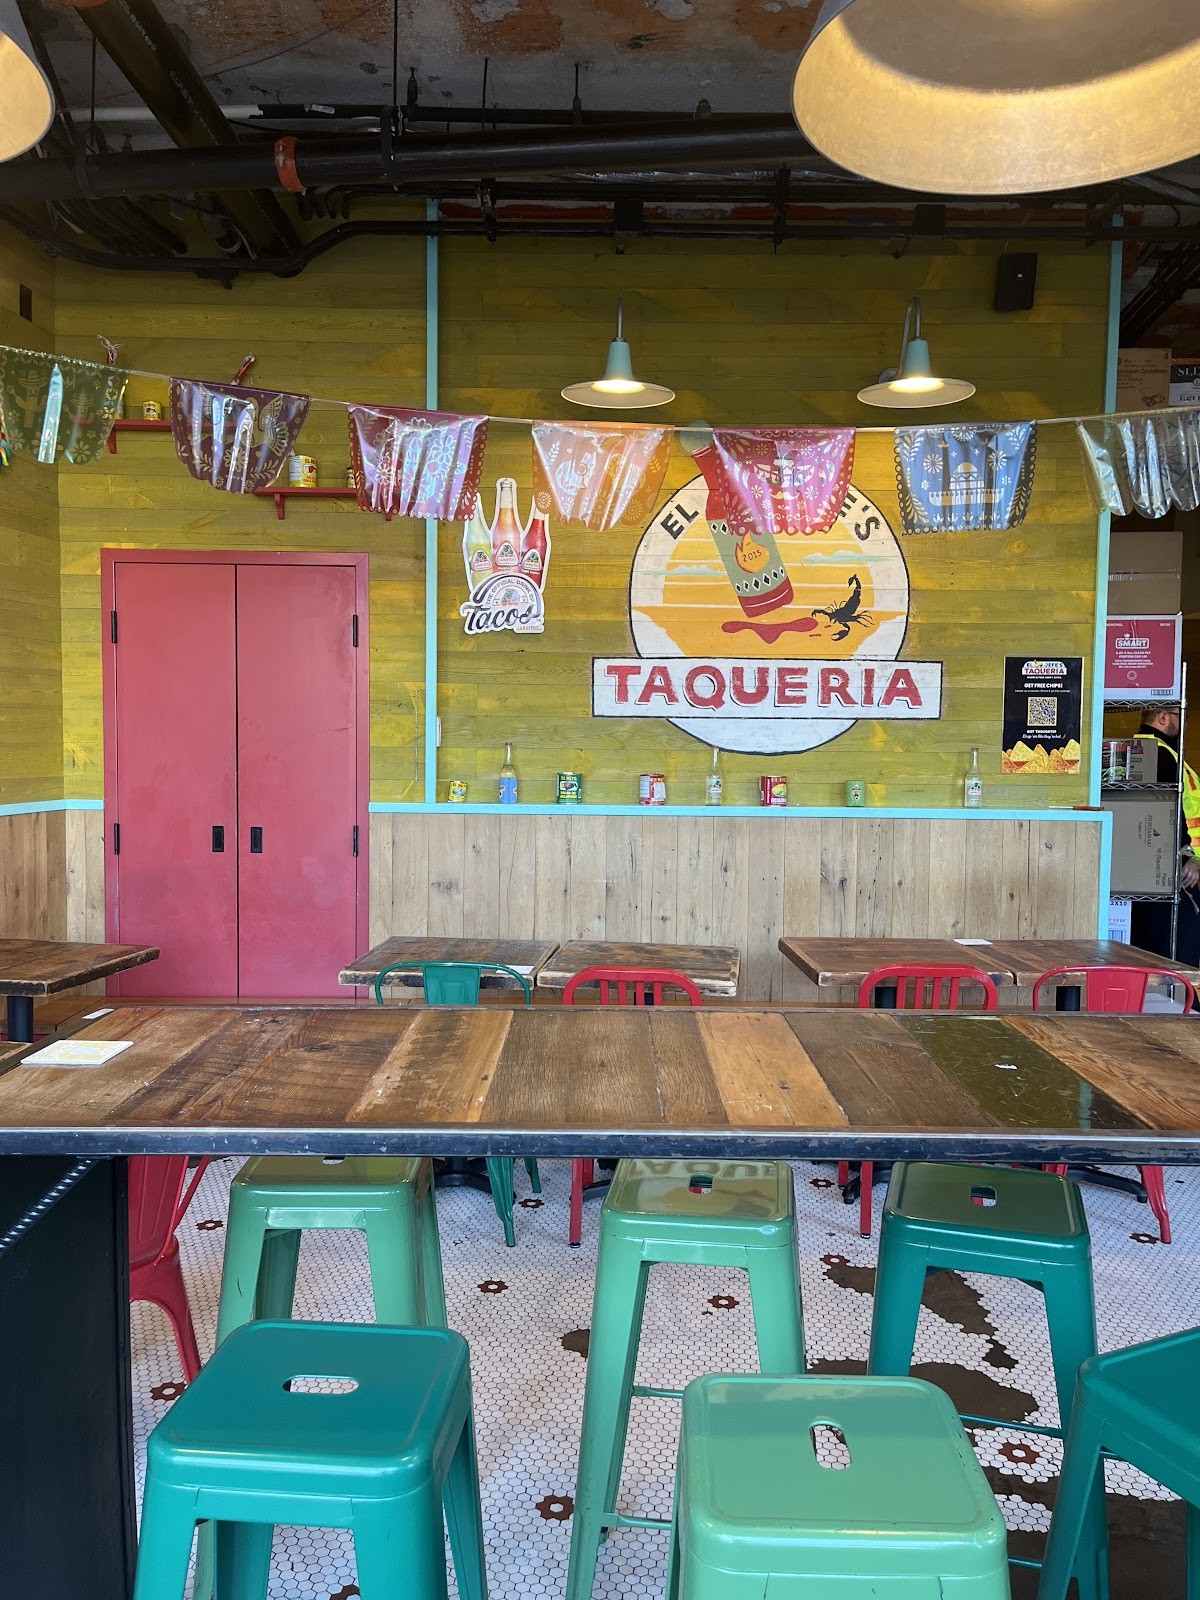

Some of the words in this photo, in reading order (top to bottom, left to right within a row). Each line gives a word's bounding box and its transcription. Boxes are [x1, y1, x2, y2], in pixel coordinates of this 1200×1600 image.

[661, 503, 699, 540] EL
[741, 549, 762, 563] 2015
[491, 578, 515, 593] OFFICIAL
[516, 578, 532, 594] DRINK
[462, 602, 540, 631] Tacos
[604, 664, 924, 711] TAQUERIA
